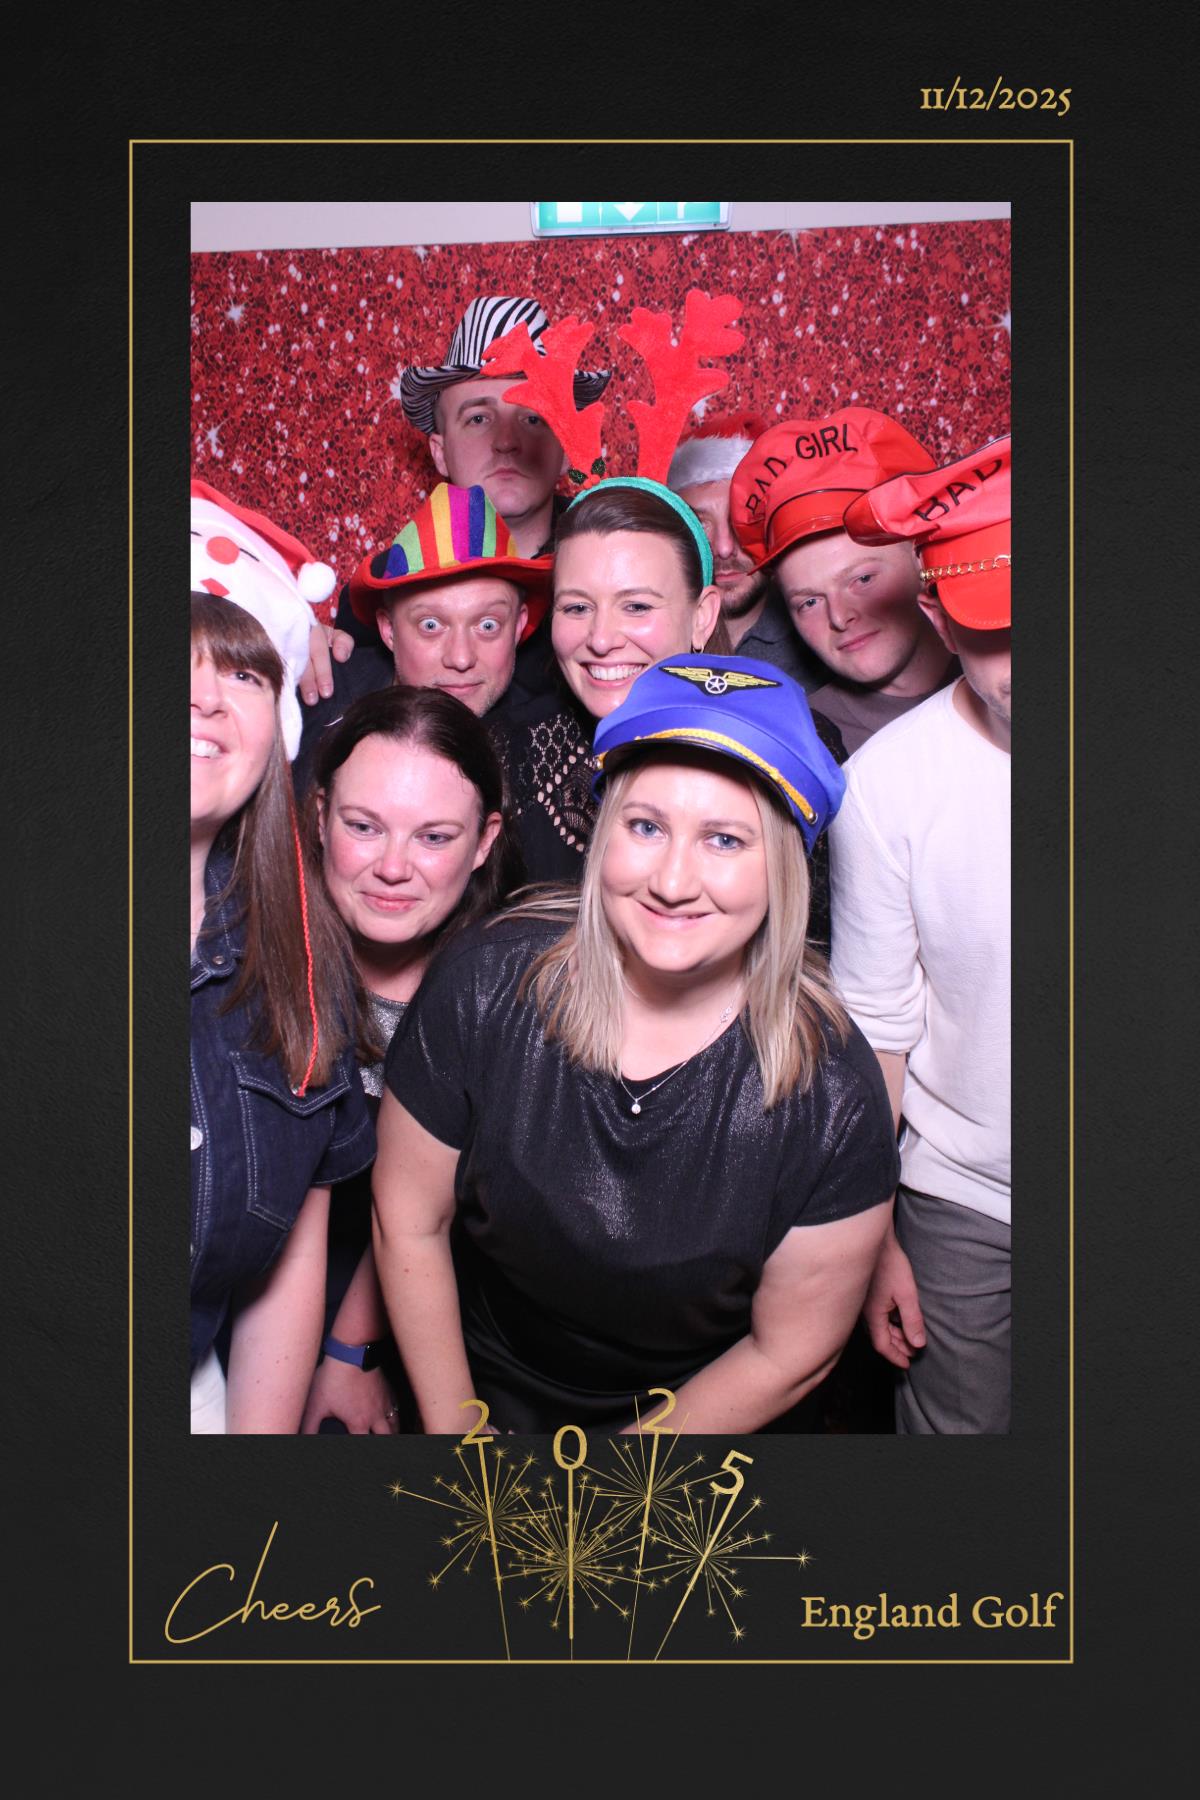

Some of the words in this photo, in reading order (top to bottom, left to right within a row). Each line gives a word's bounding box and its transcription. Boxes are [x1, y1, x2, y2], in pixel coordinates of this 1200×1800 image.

[745, 456, 788, 516] BAD
[795, 423, 858, 460] GIRL
[913, 458, 1003, 522] BAD
